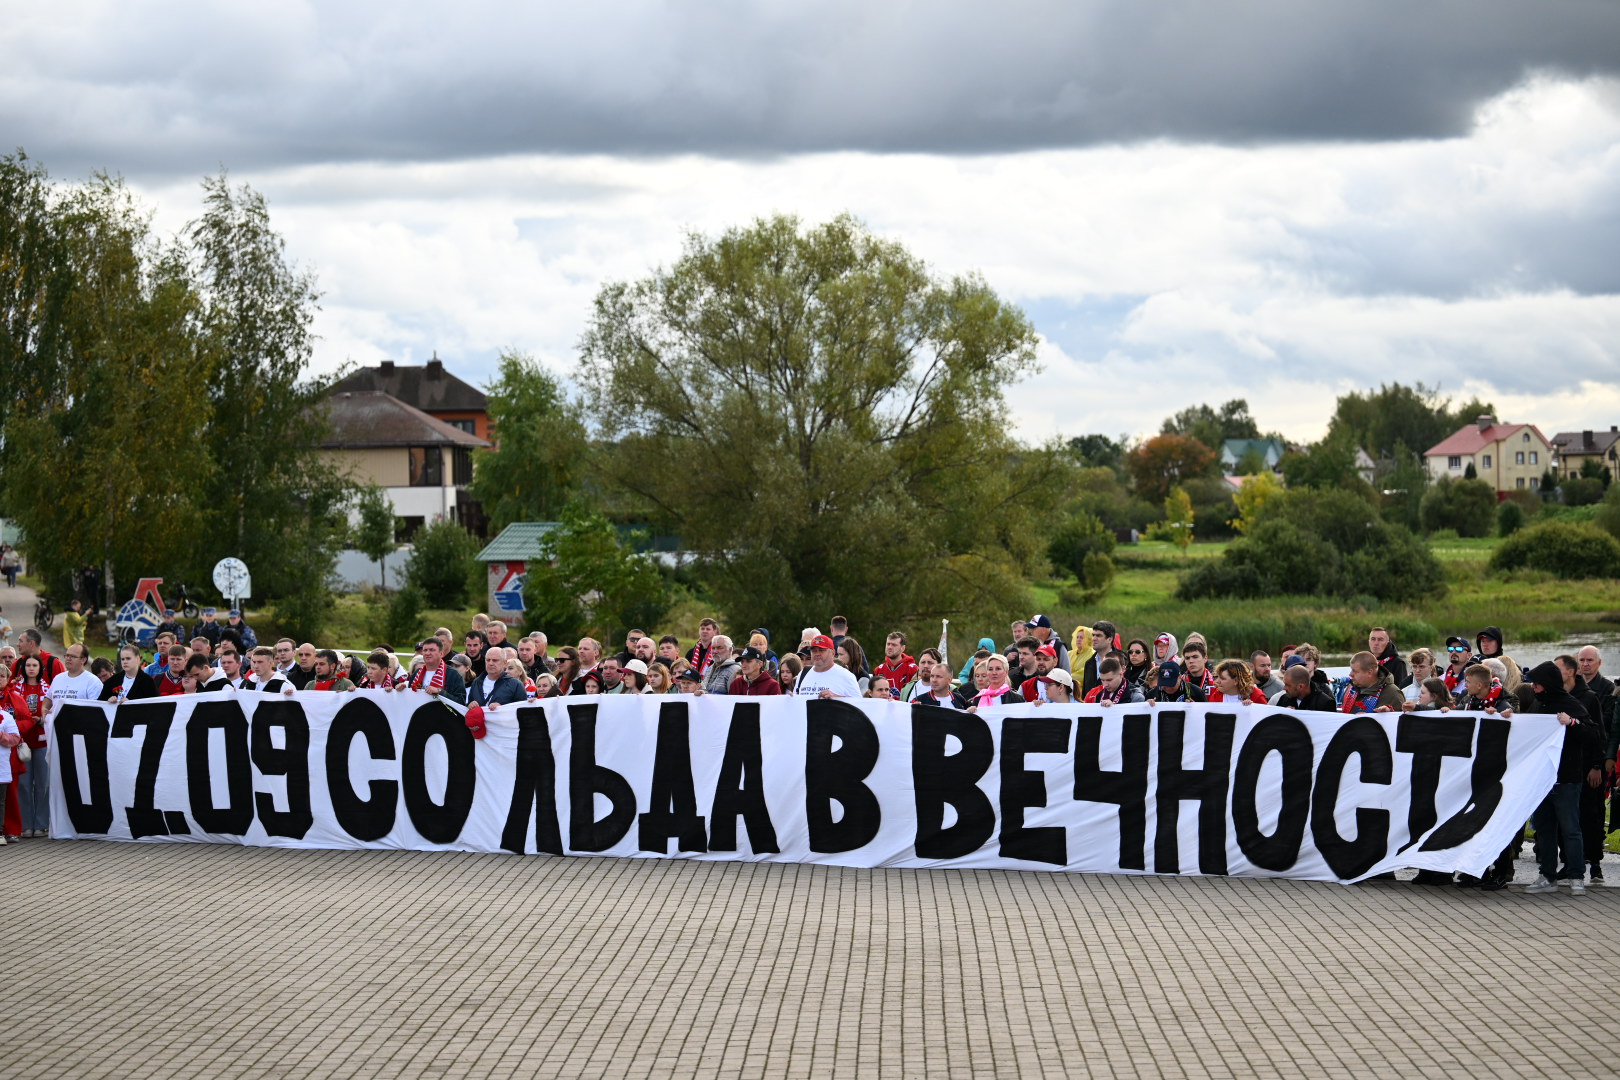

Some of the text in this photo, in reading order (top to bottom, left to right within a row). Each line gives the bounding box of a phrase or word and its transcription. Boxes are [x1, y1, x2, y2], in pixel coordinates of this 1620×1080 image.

[54, 697, 1511, 881] 07.09 СО ЛЬДА В ВЕЧНОСТЬ
